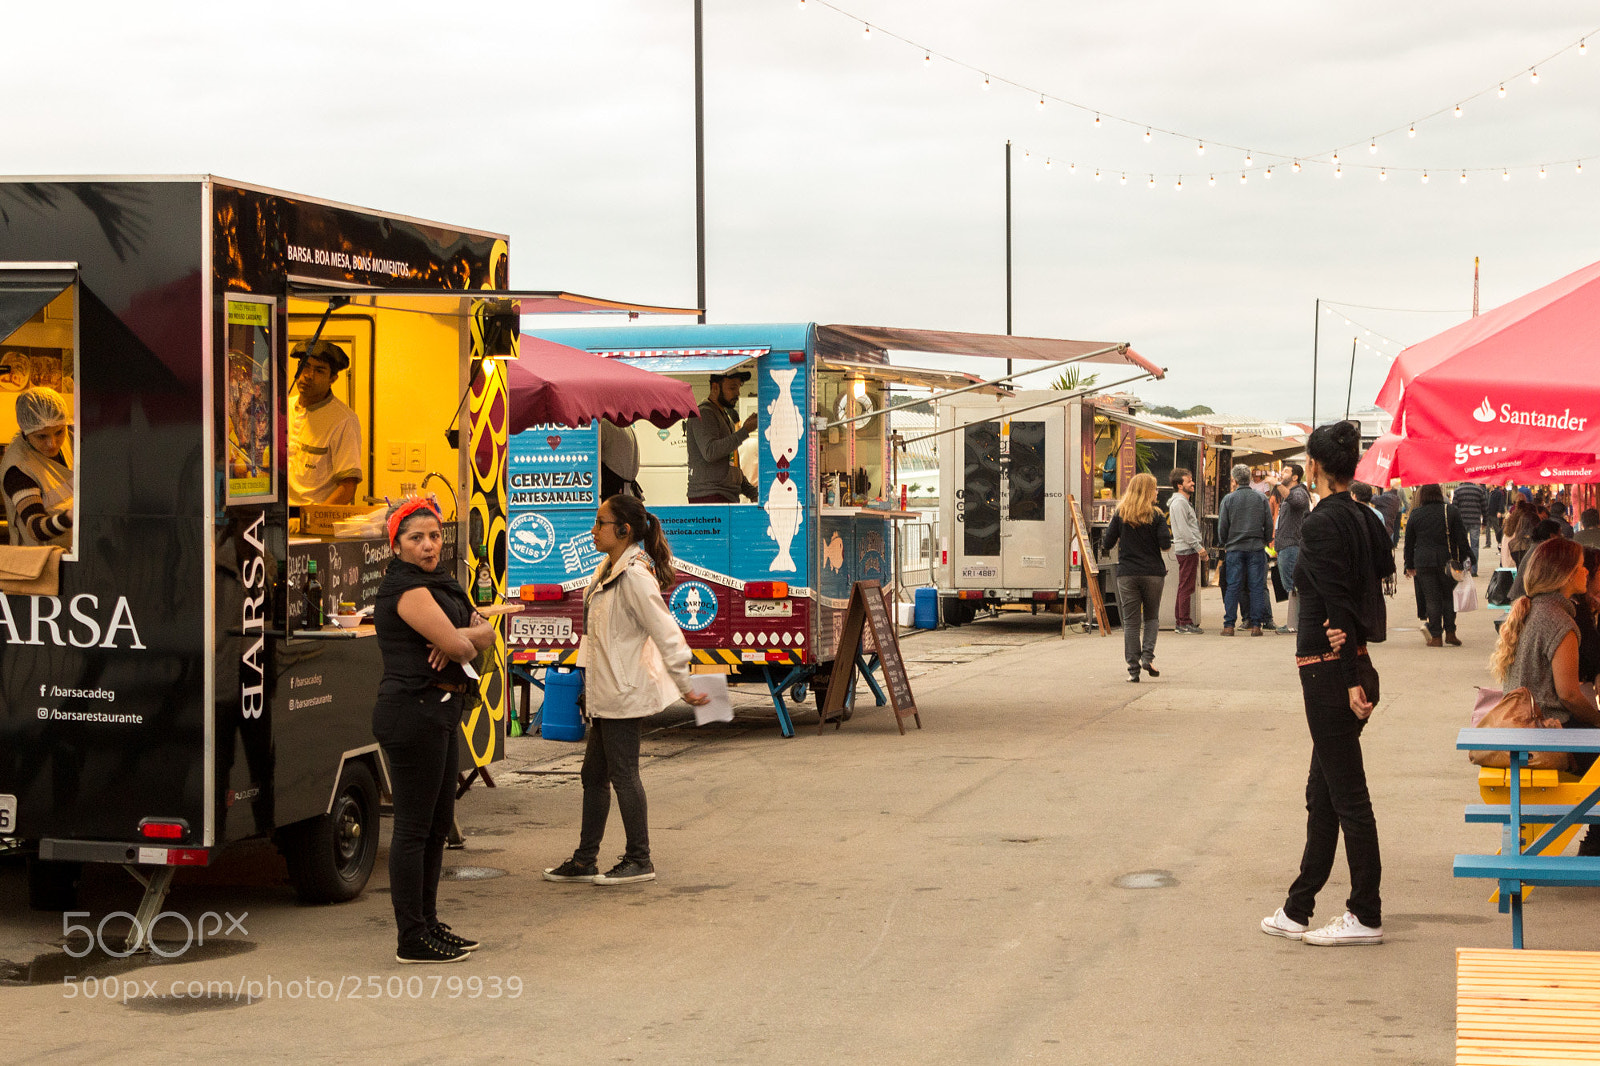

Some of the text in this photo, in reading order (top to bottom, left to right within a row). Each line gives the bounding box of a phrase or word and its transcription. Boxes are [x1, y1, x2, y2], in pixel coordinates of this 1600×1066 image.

[287, 245, 411, 277] BARSA. BOA MESA, BONS MOMENTOS.
[1500, 403, 1588, 432] Santander
[1464, 460, 1522, 474] Una empresa Santander
[1552, 467, 1593, 477] Santander
[510, 470, 593, 489] CERVEZAS
[510, 491, 594, 505] ARTESANALES
[314, 510, 340, 519] CORTES
[511, 515, 535, 530] CERVEJA
[513, 543, 540, 558] WEISS
[577, 543, 596, 556] PILS
[582, 560, 590, 568] LA
[673, 560, 694, 573] EJANDO
[702, 570, 721, 582] AROMA
[572, 578, 589, 589] VERTE
[672, 600, 716, 611] LA CARIOCA
[242, 510, 266, 720] BARSA
[50, 686, 115, 702] /barsacadeg
[50, 709, 143, 724] /barsarestaurante
